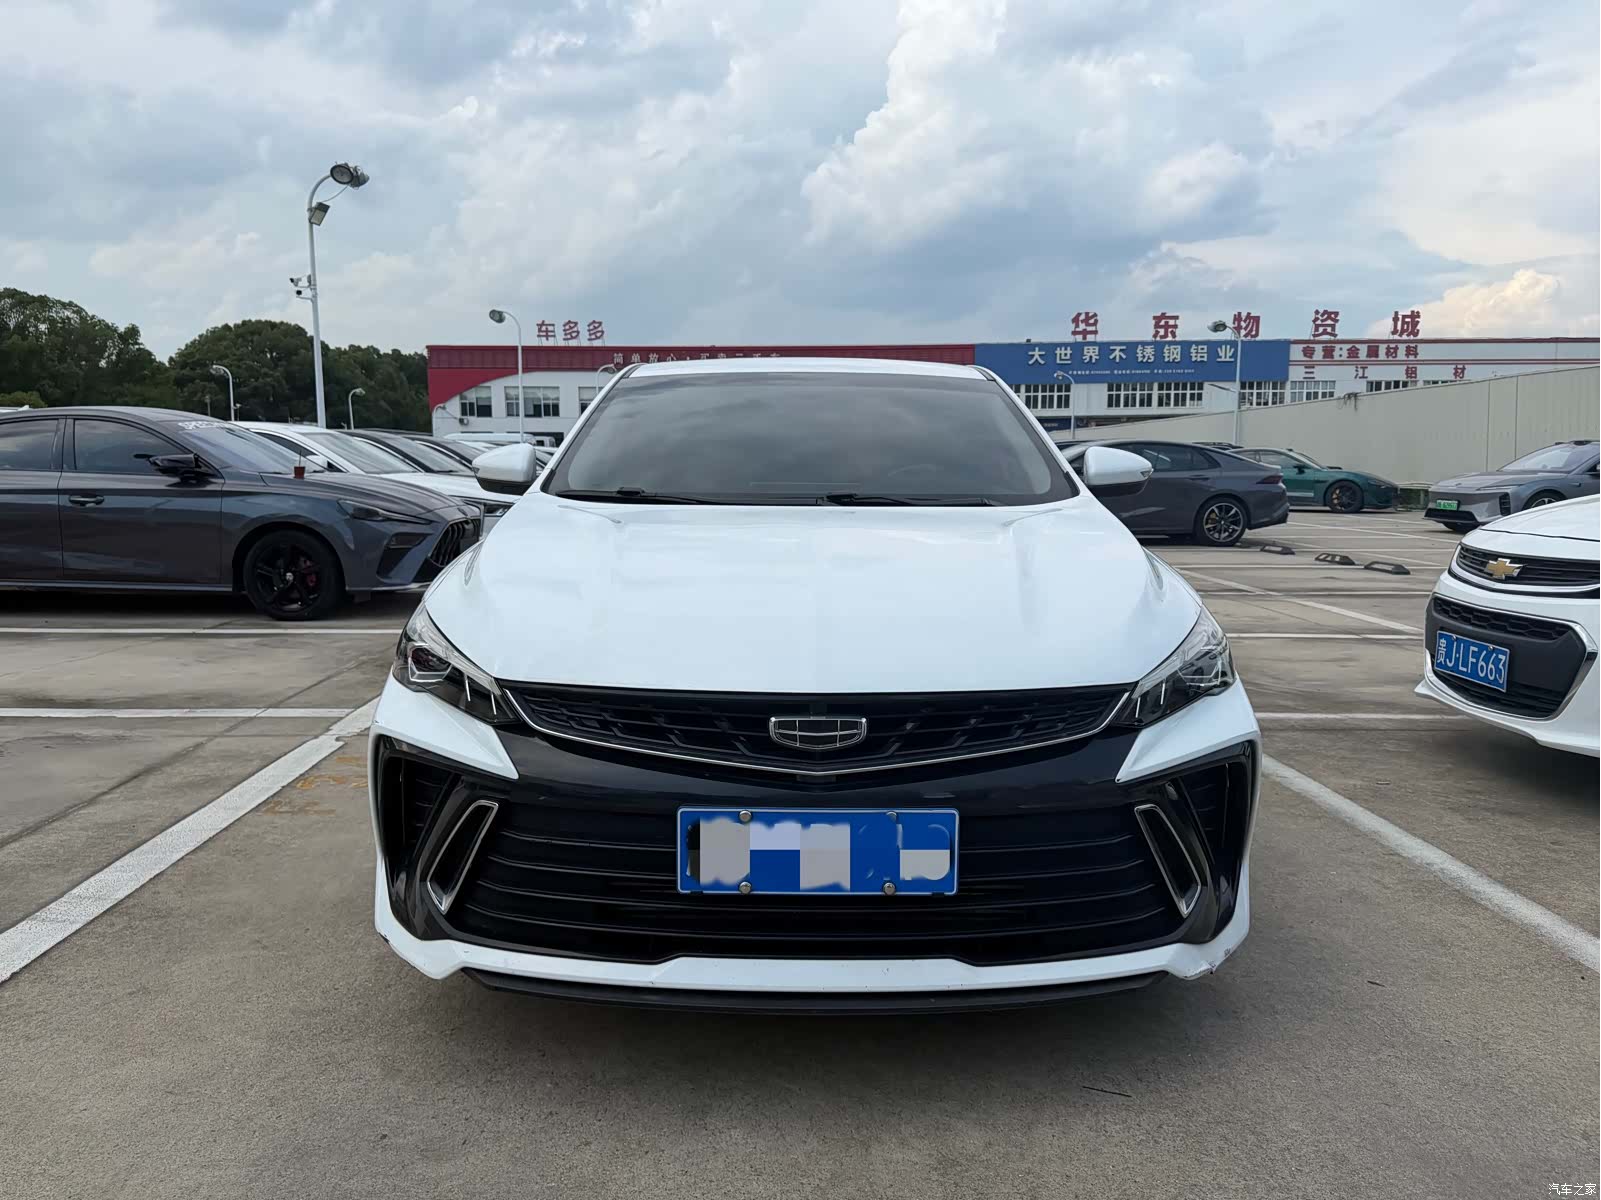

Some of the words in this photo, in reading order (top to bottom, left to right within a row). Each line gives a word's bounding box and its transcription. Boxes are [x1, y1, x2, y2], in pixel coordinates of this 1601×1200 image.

[536, 320, 605, 341] 车多多
[1071, 309, 1421, 340] 华东物资城
[1028, 344, 1235, 365] 大世界不锈钢铝业
[1303, 365, 1466, 380] 三江铝材
